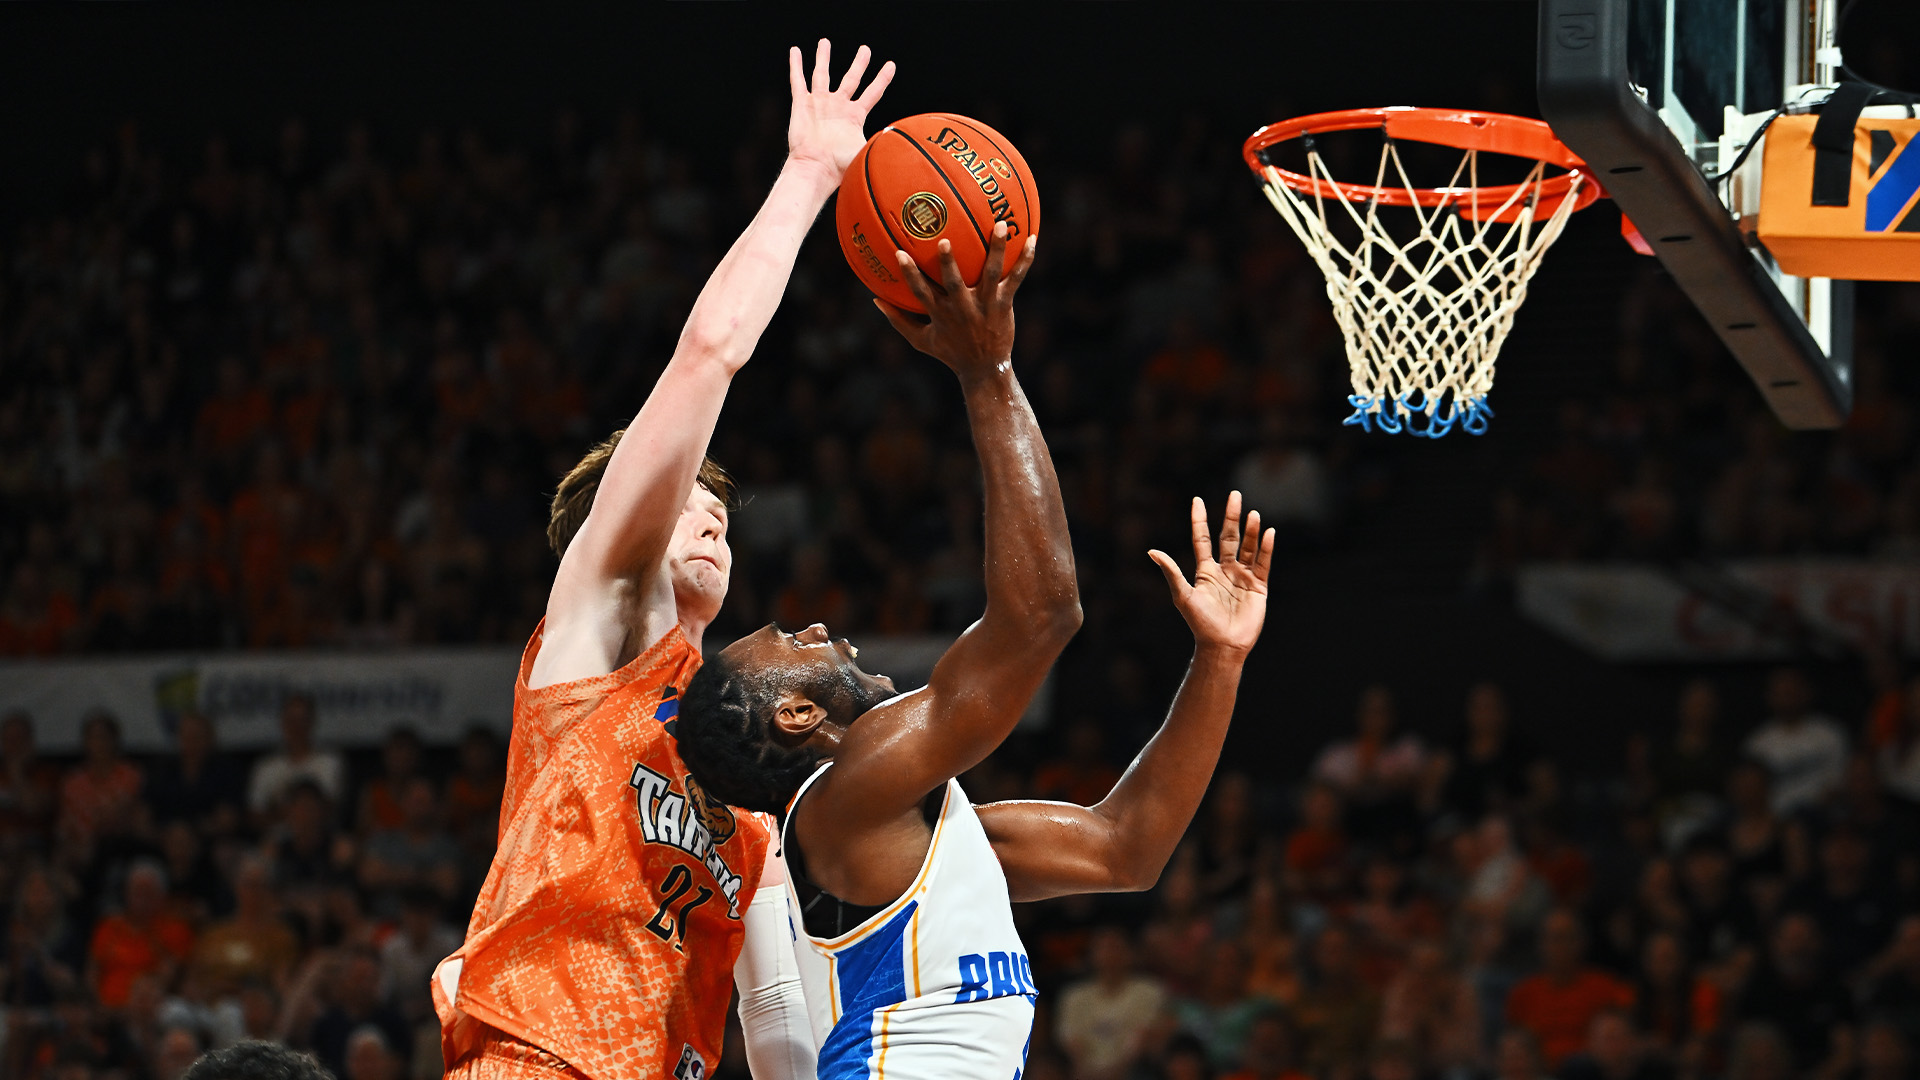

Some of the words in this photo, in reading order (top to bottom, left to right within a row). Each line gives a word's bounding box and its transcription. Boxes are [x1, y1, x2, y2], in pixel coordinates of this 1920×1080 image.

[911, 201, 937, 231] NBL
[926, 127, 1020, 241] SPALDING
[853, 222, 899, 283] LEGACY
[644, 862, 715, 954] 21
